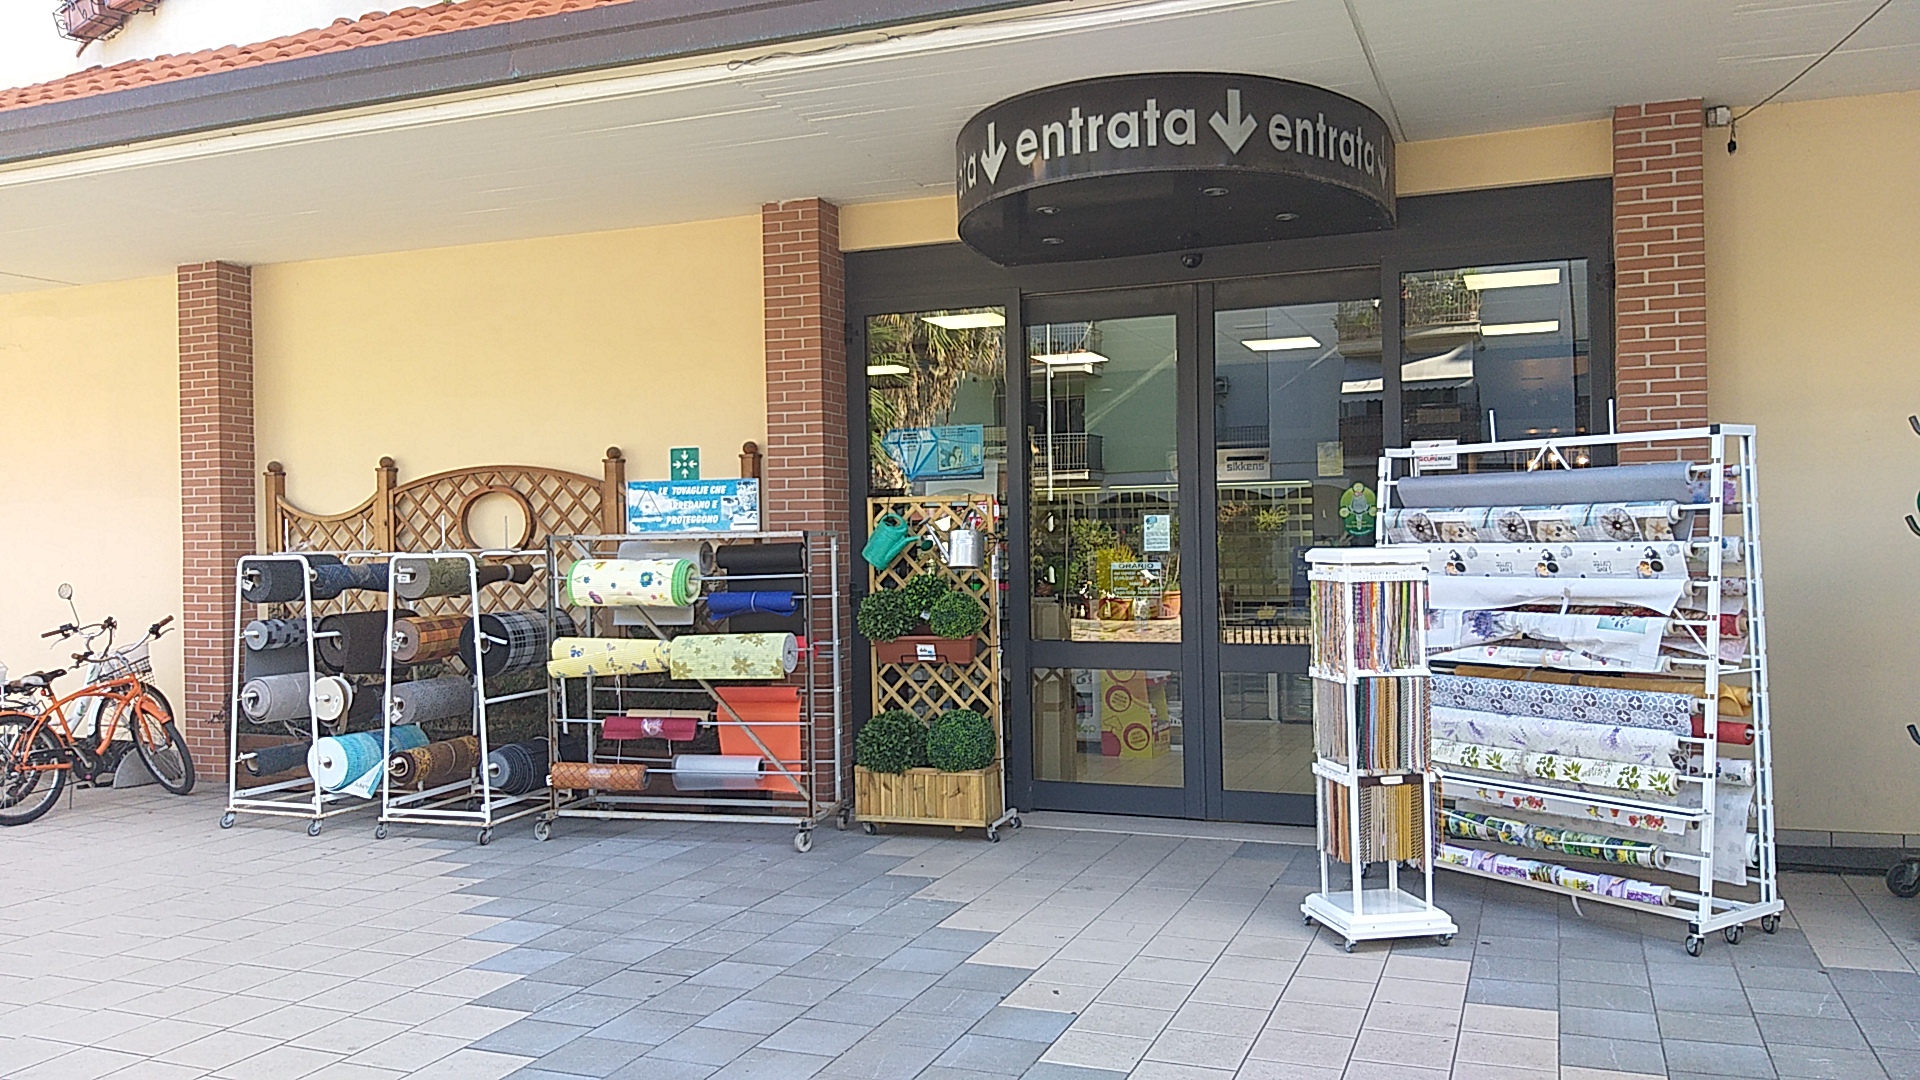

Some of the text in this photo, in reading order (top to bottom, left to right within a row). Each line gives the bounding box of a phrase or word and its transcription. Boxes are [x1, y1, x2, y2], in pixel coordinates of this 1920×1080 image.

[1015, 99, 1196, 165] entrata
[1268, 112, 1375, 175] entrata
[1226, 461, 1265, 472] sikkens
[658, 484, 727, 496] LE TOVAGLIE CHE
[711, 499, 719, 509] E
[665, 514, 719, 525] PROTEGGONO
